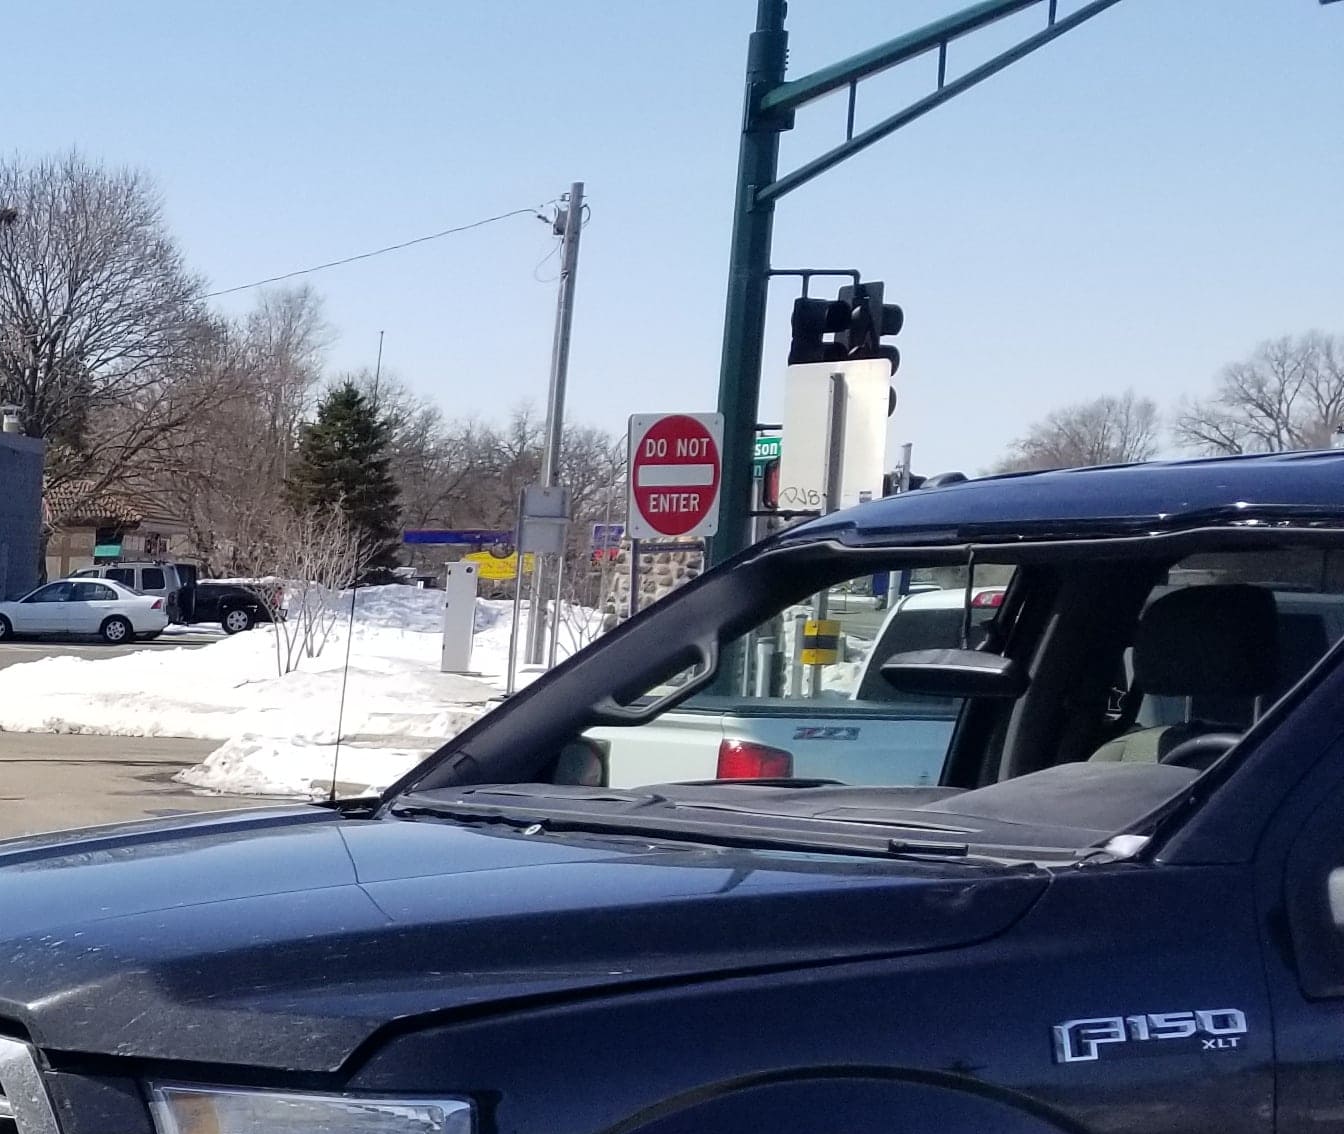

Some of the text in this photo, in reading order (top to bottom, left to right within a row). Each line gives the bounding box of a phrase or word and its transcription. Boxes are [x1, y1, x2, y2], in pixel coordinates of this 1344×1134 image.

[645, 437, 710, 458] DO NOT
[648, 493, 700, 513] ENTER
[1201, 1037, 1241, 1050] XLT
